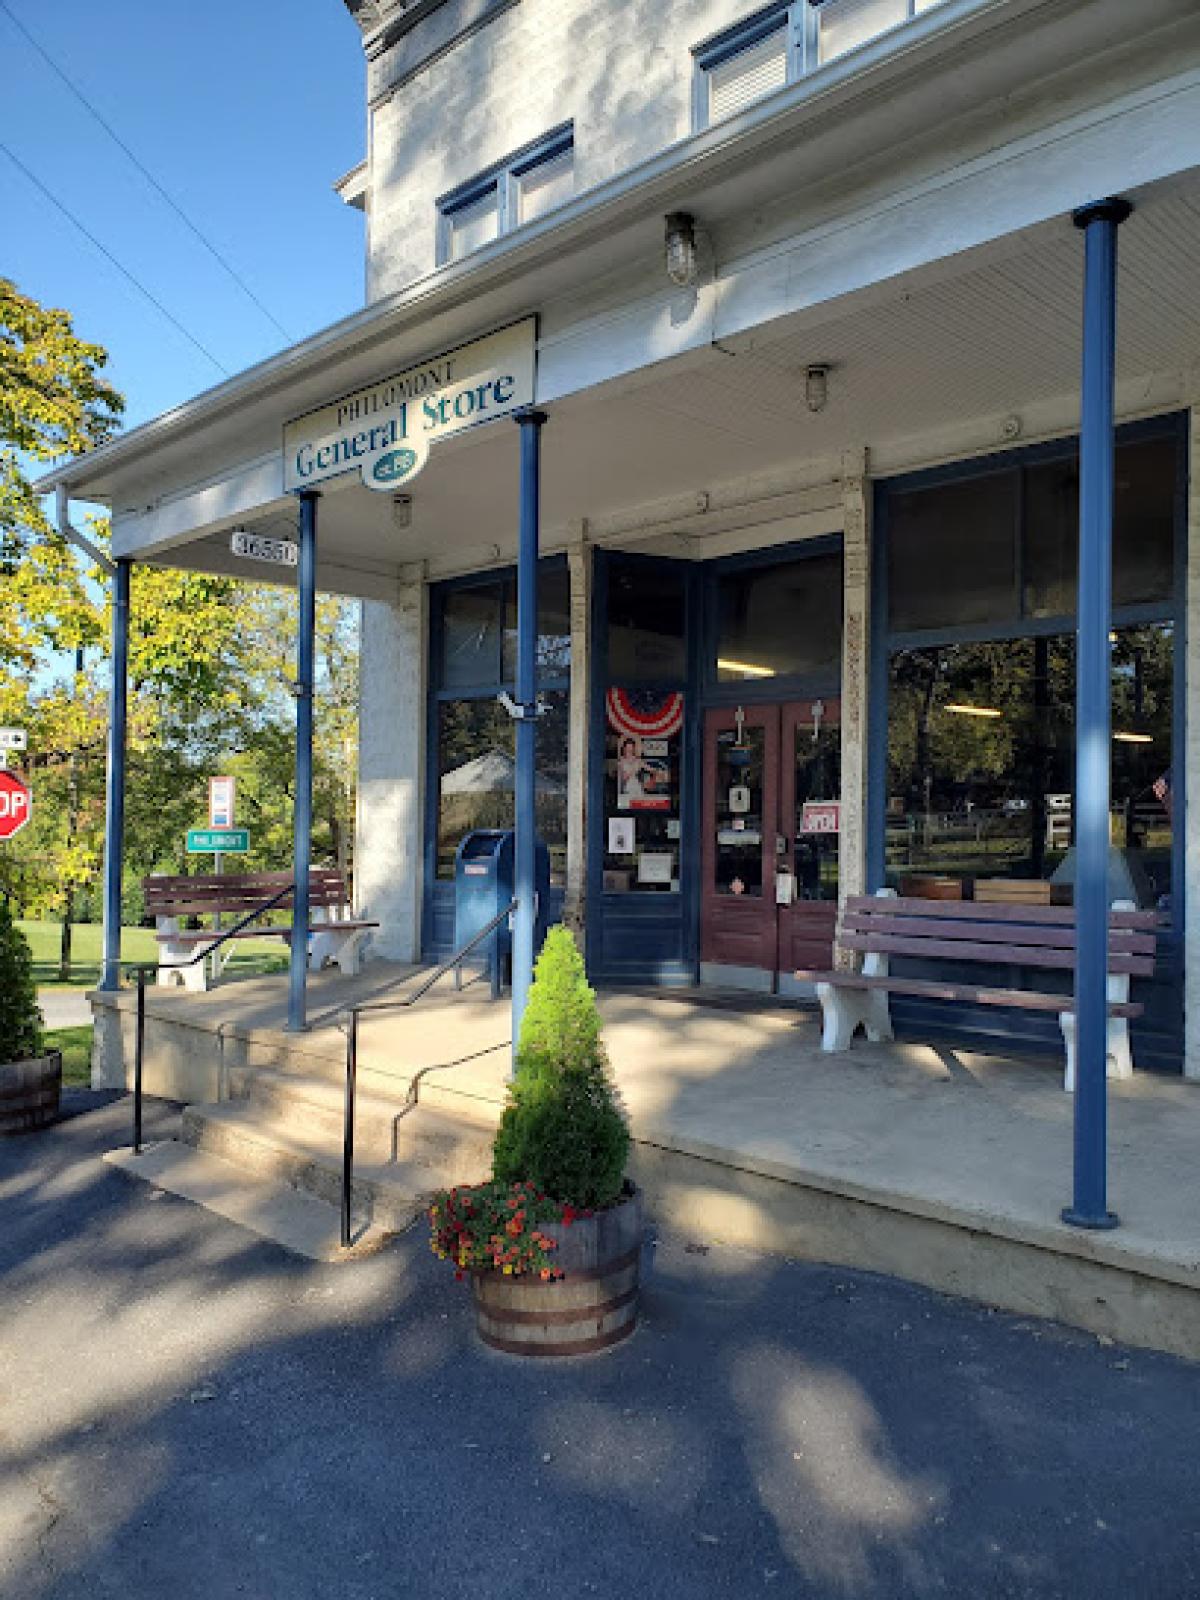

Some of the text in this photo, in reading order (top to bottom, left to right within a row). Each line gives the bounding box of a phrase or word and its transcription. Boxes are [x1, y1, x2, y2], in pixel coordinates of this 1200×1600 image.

[296, 375, 515, 478] General Store
[337, 358, 457, 427] PHILOMONT
